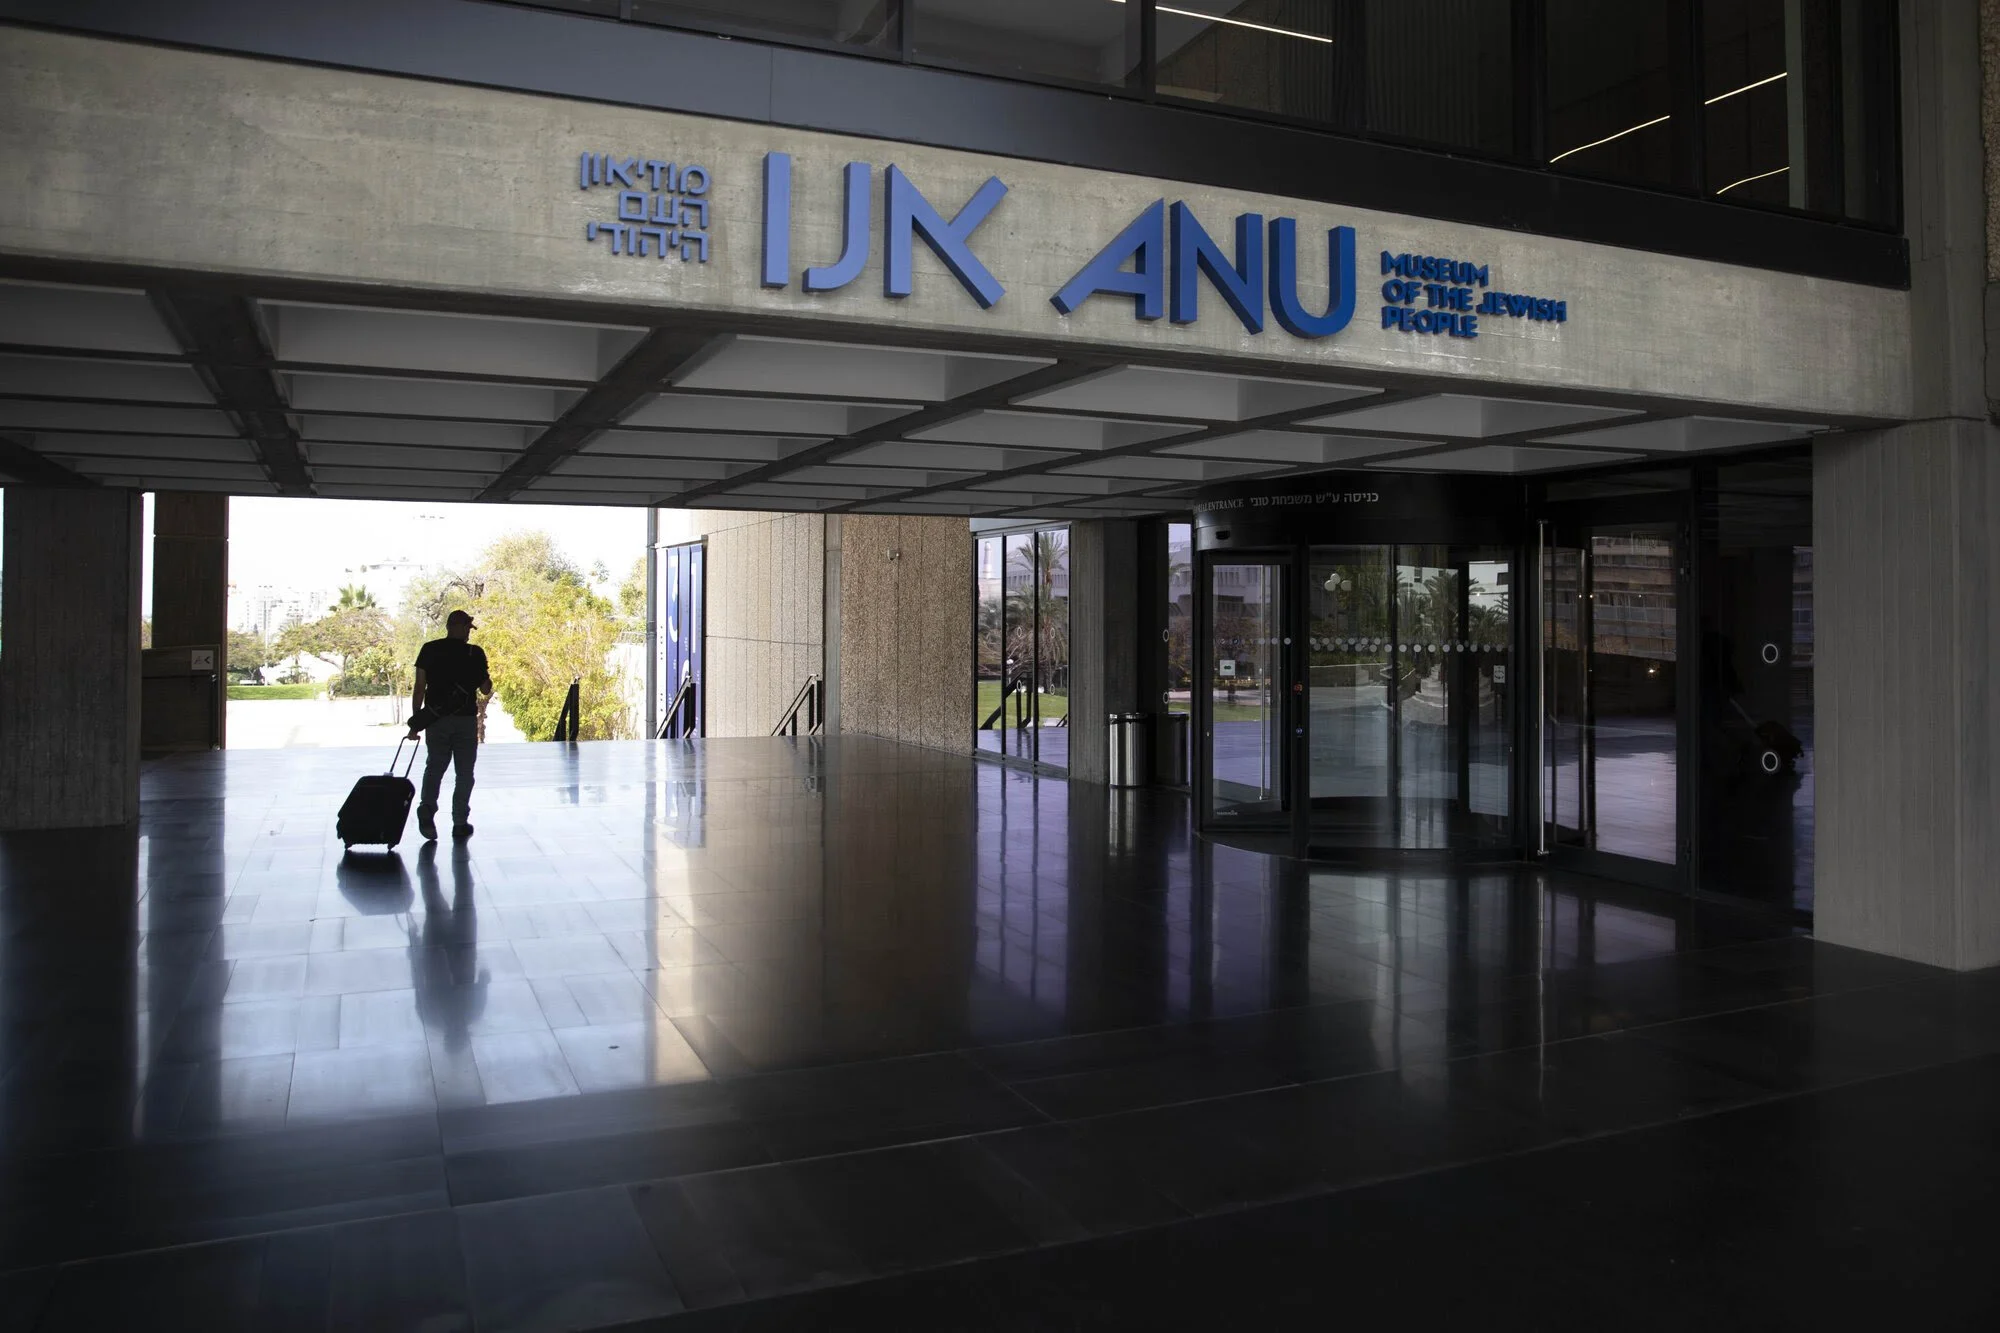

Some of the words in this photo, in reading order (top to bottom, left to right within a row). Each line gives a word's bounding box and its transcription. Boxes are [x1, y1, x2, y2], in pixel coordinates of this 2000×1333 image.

[580, 151, 711, 196] מוזיאון
[618, 190, 708, 229] העם
[587, 220, 708, 263] היהודי
[761, 151, 1009, 310] אנו
[1049, 197, 1356, 340] ANU
[1381, 250, 1488, 288] MUSEUM
[1382, 278, 1422, 304] OF
[1424, 283, 1473, 312] THE
[1476, 291, 1567, 323] JEWISH
[1381, 305, 1478, 338] PEOPLE
[1208, 498, 1244, 511] ENTRANCE
[1271, 494, 1312, 505] משפחת
[1344, 492, 1380, 503] כניסה
